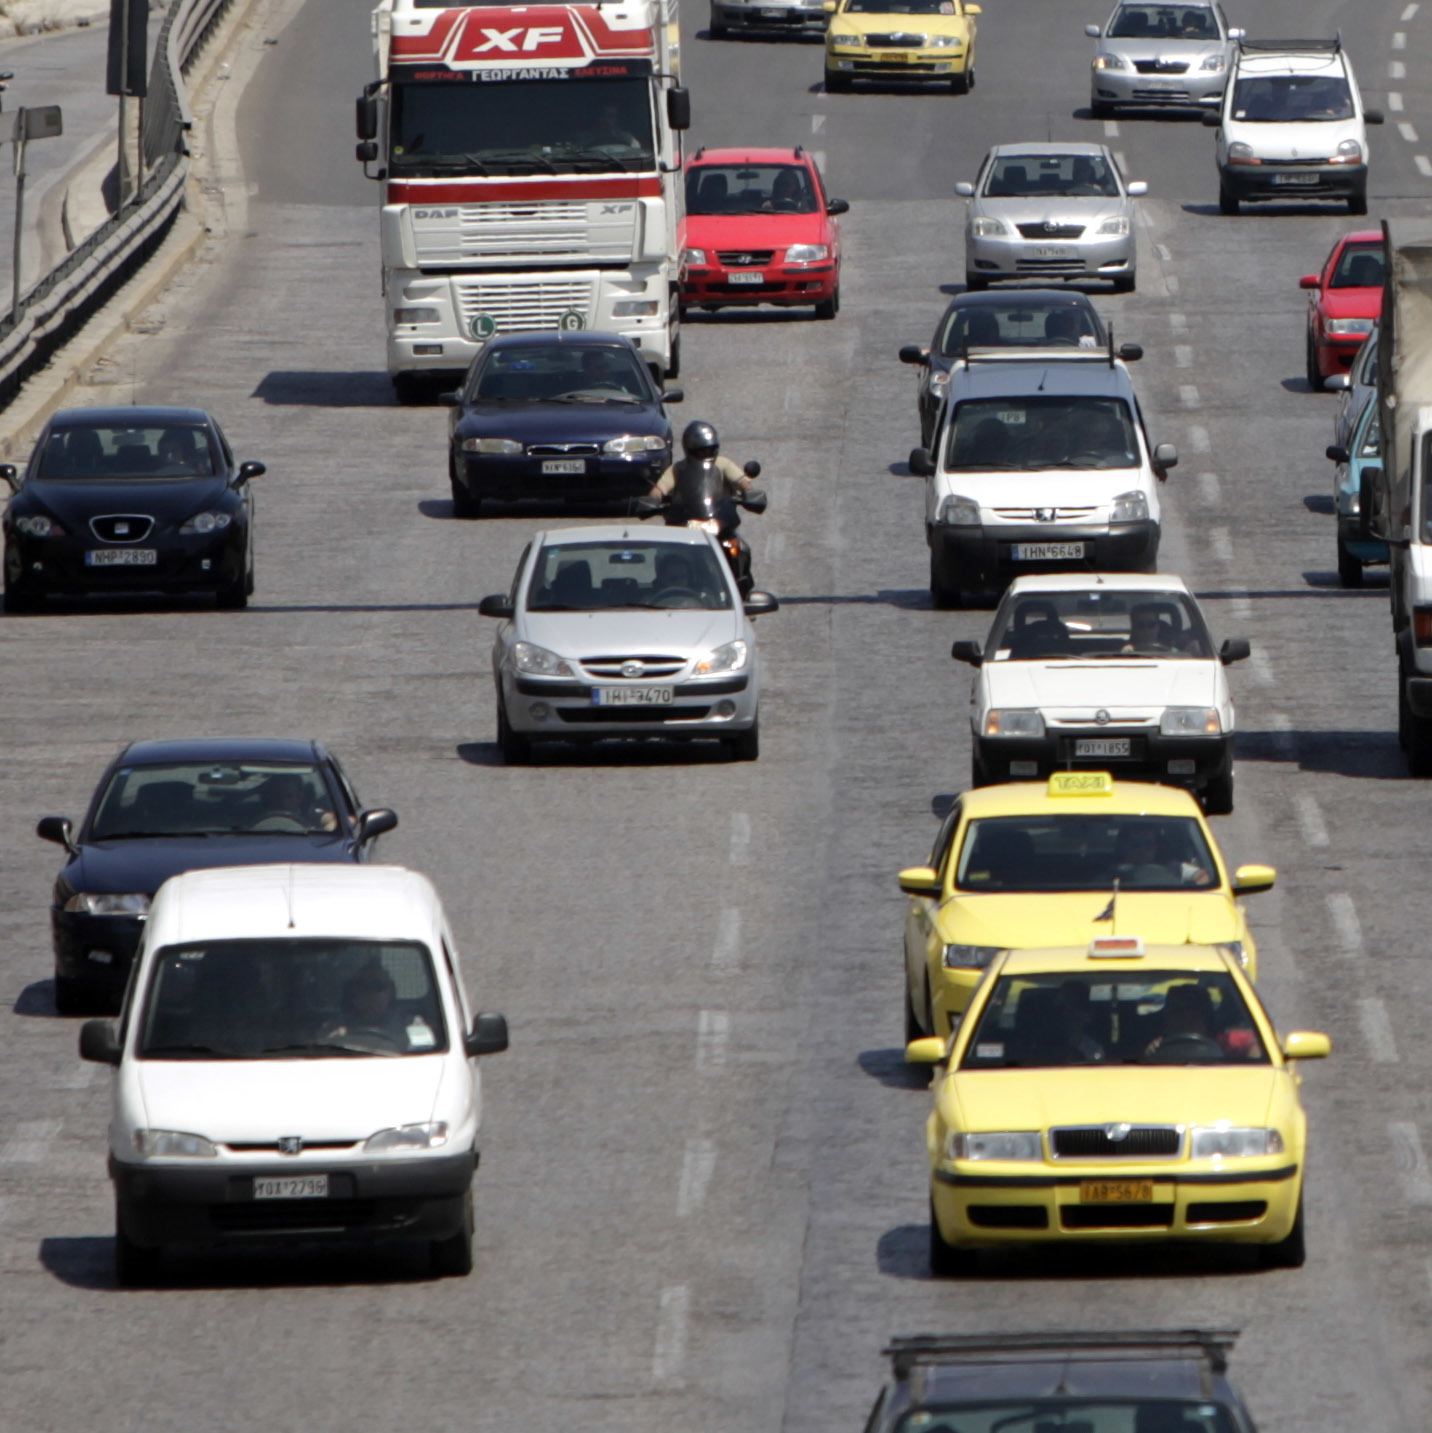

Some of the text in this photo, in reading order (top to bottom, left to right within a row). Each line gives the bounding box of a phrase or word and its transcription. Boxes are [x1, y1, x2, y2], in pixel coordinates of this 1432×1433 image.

[472, 27, 564, 52] XF
[471, 67, 569, 82] ΓΕΩΡΓΑΝΤΑΣ
[414, 208, 458, 219] DAF
[600, 204, 632, 215] XF
[476, 320, 489, 336] L
[566, 315, 579, 330] G
